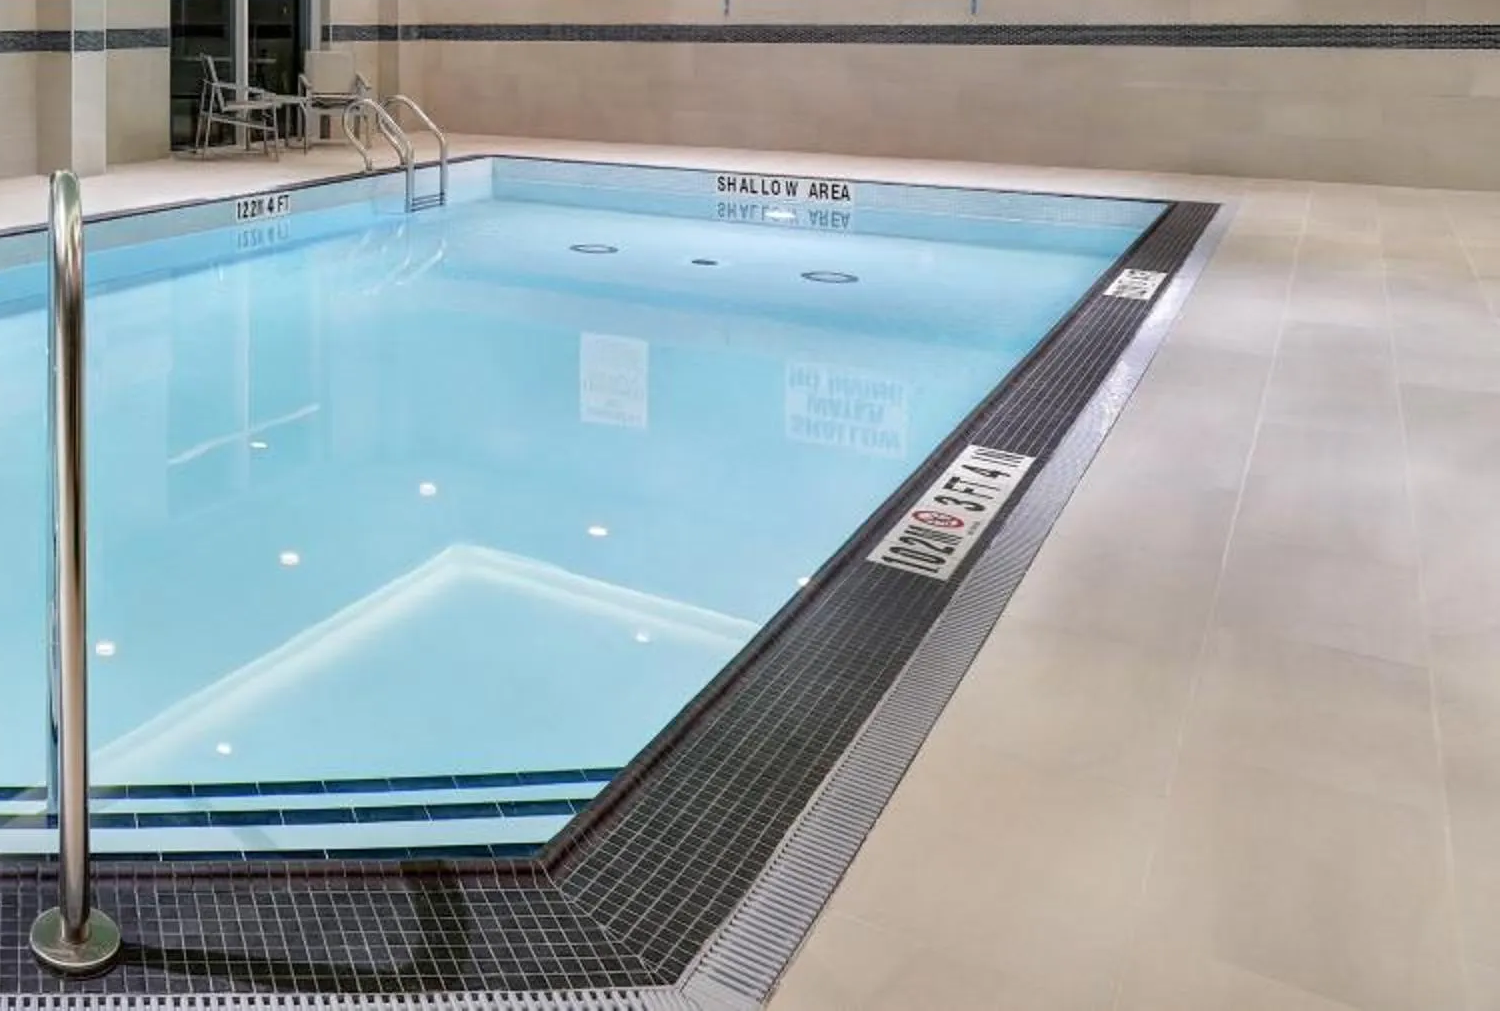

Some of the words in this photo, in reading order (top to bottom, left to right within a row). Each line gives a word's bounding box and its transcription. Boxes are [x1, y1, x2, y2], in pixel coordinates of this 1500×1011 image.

[717, 175, 799, 197] SHALLOW
[808, 182, 850, 201] AREA
[267, 196, 274, 213] 4
[277, 194, 289, 213] FT
[961, 464, 1011, 479] 4
[943, 476, 1001, 500] FT
[933, 494, 986, 512] 3
[881, 524, 964, 574] 102M
